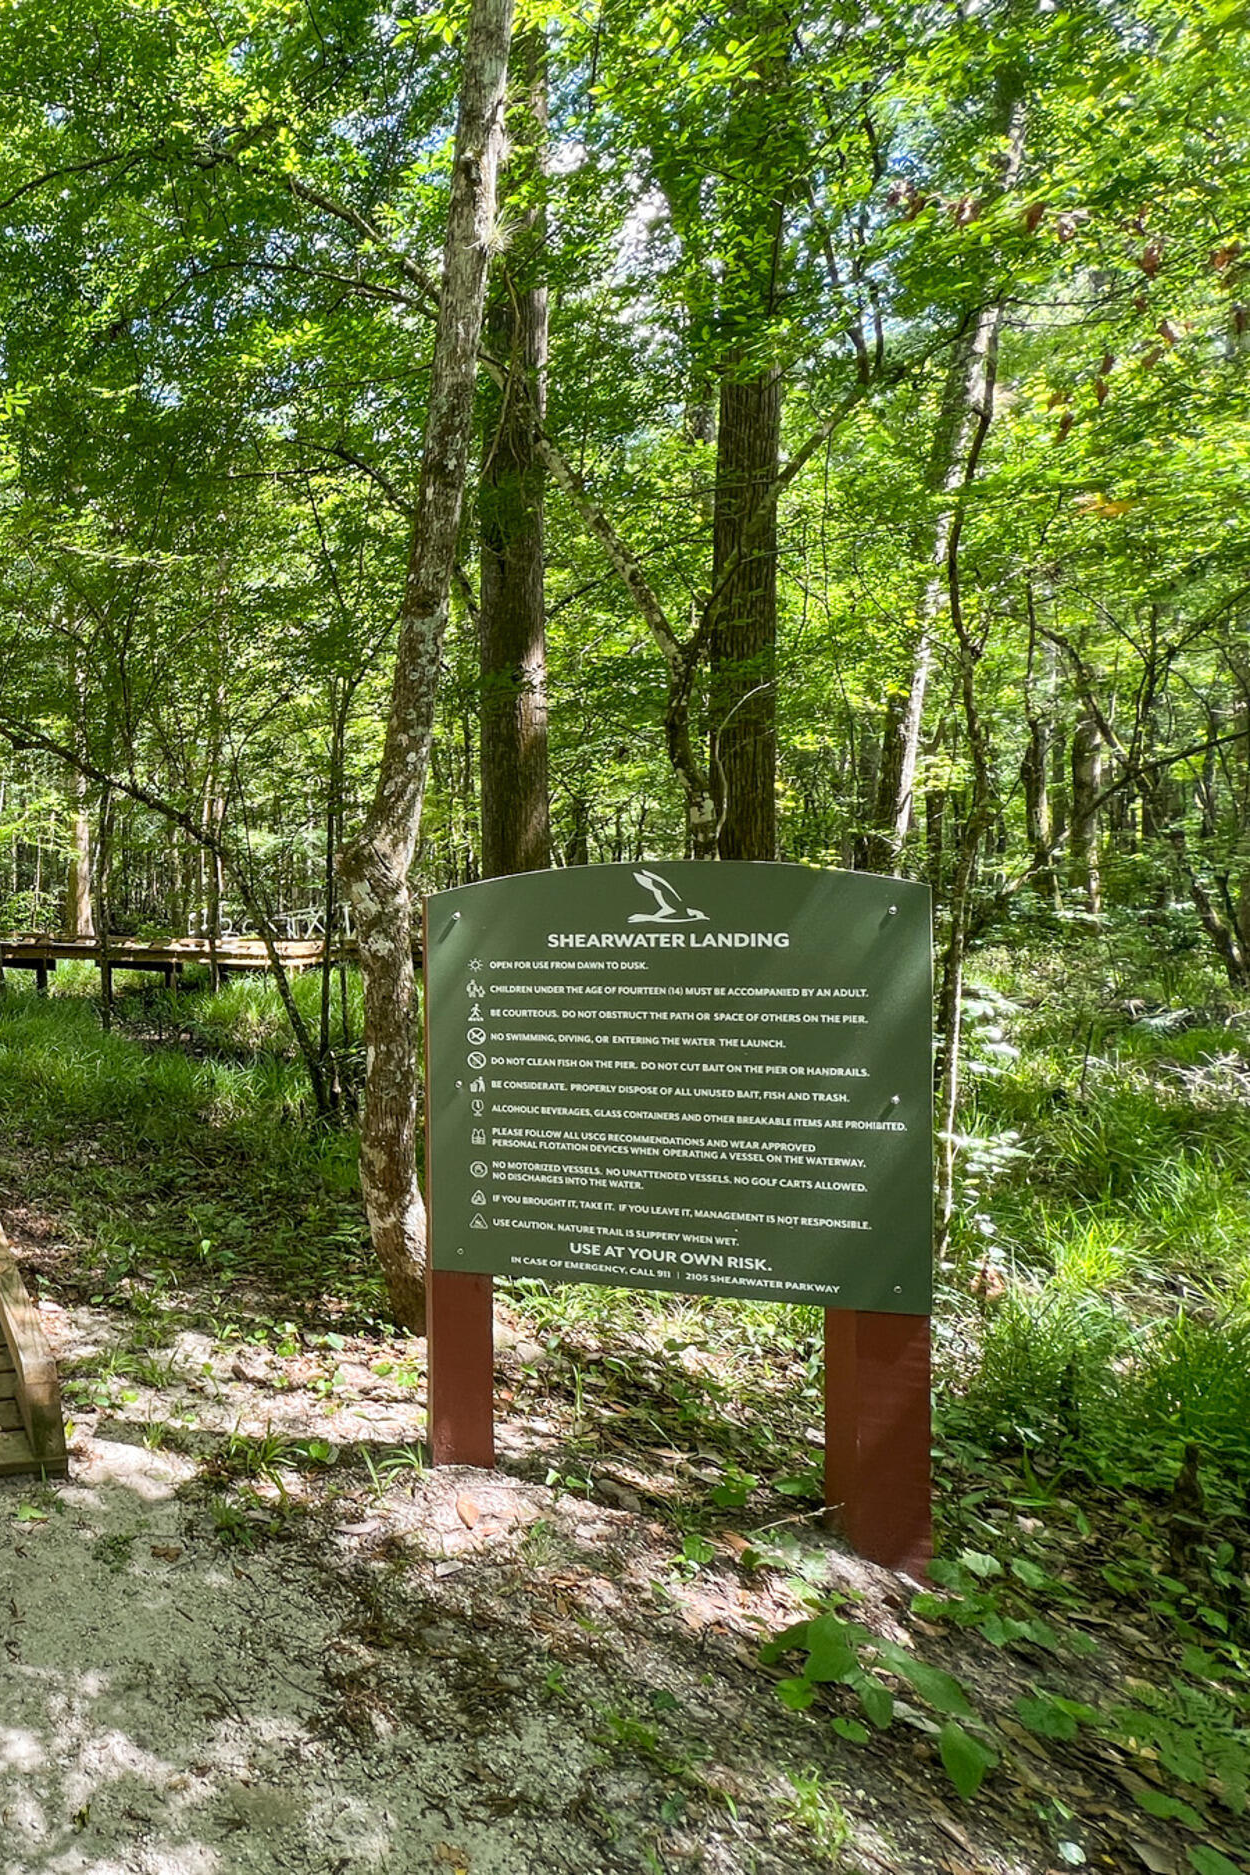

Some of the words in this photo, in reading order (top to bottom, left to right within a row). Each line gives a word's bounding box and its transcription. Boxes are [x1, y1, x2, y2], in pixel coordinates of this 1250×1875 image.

[548, 934, 686, 947] SHEARWATER
[690, 933, 789, 947] LANDING
[489, 961, 513, 969] OPEN
[514, 961, 531, 969] FOR
[532, 961, 549, 969] USE
[550, 961, 576, 969] FROM
[576, 961, 605, 969] DAWN
[605, 961, 619, 969] TO
[620, 962, 649, 970] DUSK.
[490, 985, 533, 993] CHILDREN
[565, 986, 584, 994] THE
[584, 986, 603, 994] AGE
[604, 986, 617, 994] OF
[618, 986, 667, 995] FOURTEEN
[668, 987, 683, 996] (14)
[685, 987, 713, 995] MUST
[713, 987, 726, 995] BE
[727, 988, 800, 996] ACCOMPANIED
[832, 989, 869, 997] ADULT.
[490, 1009, 501, 1017] BE
[502, 1009, 560, 1018] COURTEOUS.
[562, 1010, 577, 1018] DO
[598, 1011, 649, 1019] OBSTRUCT
[649, 1012, 669, 1020] THE
[669, 1012, 695, 1020] PATH
[696, 1012, 711, 1020] OR
[713, 1013, 745, 1021] SPACE
[760, 1014, 801, 1022] OTHERS
[802, 1014, 819, 1022] ON
[820, 1015, 841, 1023] THE
[842, 1015, 869, 1023] PIER.
[490, 1033, 505, 1041] NO
[505, 1033, 557, 1042] SWIMMING,
[558, 1034, 594, 1044] DIVING,
[594, 1035, 609, 1043] OR
[612, 1036, 660, 1045] ENTERING
[660, 1037, 681, 1045] THE
[681, 1038, 716, 1046] WATER
[718, 1039, 739, 1047] THE
[740, 1039, 786, 1048] LAUNCH.
[490, 1057, 505, 1065] DO
[506, 1057, 526, 1065] NOT
[526, 1058, 556, 1066] CLEAN
[557, 1059, 578, 1067] FISH
[578, 1060, 594, 1068] ON
[594, 1060, 613, 1068] THE
[614, 1061, 639, 1069] PIER.
[640, 1062, 656, 1070] DO
[657, 1062, 679, 1071] NOT
[680, 1063, 701, 1071] CUT
[702, 1064, 725, 1072] BAIT
[726, 1064, 743, 1072] ON
[743, 1065, 764, 1074] THE
[765, 1066, 788, 1074] PIER
[789, 1067, 805, 1075] OR
[806, 1067, 870, 1077] HANDRAILS.
[491, 1080, 503, 1088] BE
[503, 1081, 568, 1091] CONSIDERATE.
[570, 1083, 617, 1093] PROPERLY
[618, 1086, 659, 1095] DISPOSE
[659, 1087, 673, 1095] OF
[674, 1088, 693, 1096] ALL
[693, 1089, 735, 1098] UNUSED
[736, 1090, 762, 1100] BAIT,
[763, 1091, 786, 1100] FISH
[787, 1092, 811, 1100] AND
[811, 1093, 850, 1102] TRASH.
[491, 1105, 540, 1114] ALCOHOLIC
[540, 1107, 593, 1117] BEVERAGES,
[593, 1109, 622, 1118] GLASS
[622, 1111, 680, 1121] CONTAINERS
[681, 1113, 702, 1122] AND
[703, 1114, 735, 1123] OTHER
[736, 1116, 792, 1126] BREAKABLE
[793, 1118, 823, 1128] ITEMS
[824, 1120, 843, 1128] ARE
[845, 1121, 907, 1131] PROHIBITED.
[492, 1128, 524, 1136] PLEASE
[524, 1129, 562, 1138] FOLLOW
[562, 1131, 580, 1139] ALL
[580, 1132, 607, 1141] USCG
[608, 1133, 705, 1146] RECOMMENDATIONS
[706, 1139, 729, 1148] AND
[729, 1140, 760, 1149] WEAR
[760, 1142, 816, 1152] APPROVED
[492, 1139, 538, 1149] PERSONAL
[538, 1141, 589, 1151] FLOTATION
[590, 1144, 629, 1154] DEVICES
[630, 1147, 660, 1156] WHEN
[662, 1148, 719, 1159] OPERATING
[728, 1152, 765, 1162] VESSEL
[766, 1154, 783, 1163] ON
[783, 1155, 805, 1164] THE
[805, 1157, 867, 1167] WATERWAY.
[492, 1161, 506, 1169] NO
[507, 1162, 561, 1172] MOTORIZED
[561, 1165, 603, 1175] VESSELS.
[605, 1168, 621, 1176] NO
[622, 1169, 687, 1180] UNATTENDED
[688, 1173, 732, 1184] VESSELS.
[733, 1176, 750, 1185] NO
[751, 1177, 778, 1186] GOLF
[778, 1179, 813, 1189] CARTS
[814, 1181, 868, 1192] ALLOWED.
[492, 1172, 507, 1180] NO
[507, 1173, 564, 1184] DISCHARGES
[564, 1177, 589, 1186] INTO
[588, 1178, 608, 1187] THE
[608, 1180, 644, 1189] WATER.
[501, 1195, 521, 1204] YOU
[522, 1197, 567, 1207] BROUGHT
[567, 1200, 579, 1209] IT,
[579, 1201, 603, 1210] TAKE
[604, 1203, 616, 1211] IT.
[628, 1205, 649, 1213] YOU
[650, 1207, 680, 1216] LEAVE
[681, 1209, 693, 1217] IT,
[694, 1210, 765, 1222] MANAGEMENT
[766, 1215, 776, 1223] IS
[777, 1216, 799, 1225] NOT
[800, 1217, 872, 1229] RESPONSIBLE.
[492, 1219, 511, 1227] USE
[511, 1220, 556, 1230] CAUTION.
[557, 1224, 595, 1234] NATURE
[596, 1227, 625, 1236] TRAIL
[625, 1229, 635, 1237] IS
[635, 1230, 681, 1241] SLIPPERY
[682, 1234, 713, 1244] WHEN
[714, 1237, 739, 1246] WET.
[570, 1243, 601, 1256] USE
[604, 1246, 625, 1257] AT
[627, 1247, 677, 1263] YOUR
[680, 1253, 724, 1267] OWN
[727, 1257, 772, 1271] RISK.
[522, 1257, 548, 1266] CASE
[564, 1261, 628, 1274] EMERGENCY,
[629, 1268, 656, 1277] CALL
[656, 1270, 671, 1278] 911
[685, 1272, 709, 1282] 2105
[710, 1275, 783, 1289] SHEARWATER
[784, 1282, 840, 1293] PARKWAY
